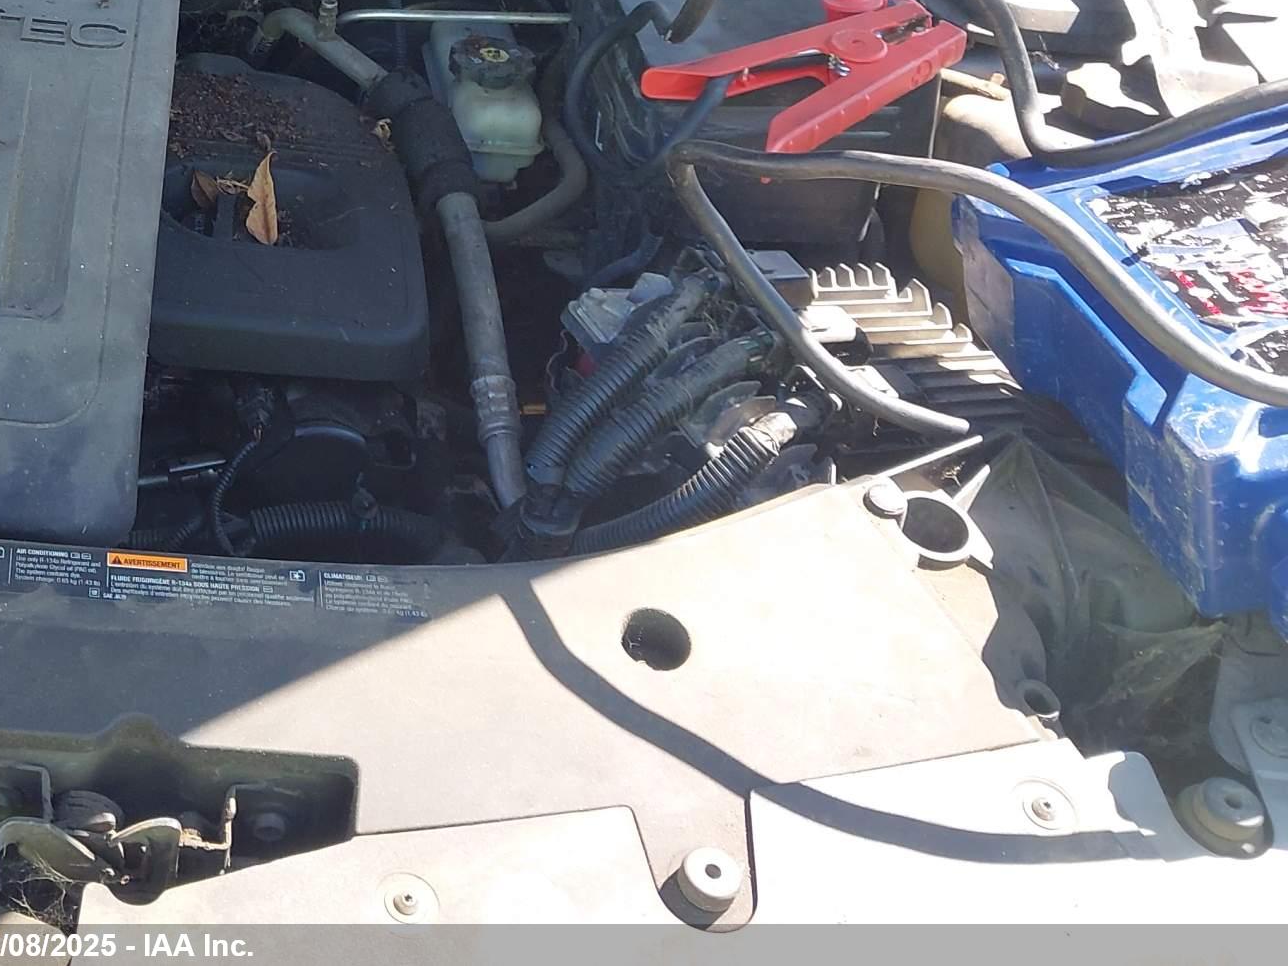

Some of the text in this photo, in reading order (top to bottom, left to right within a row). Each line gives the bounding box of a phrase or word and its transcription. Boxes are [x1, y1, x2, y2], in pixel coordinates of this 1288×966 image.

[28, 549, 69, 557] CONDITIONING
[123, 558, 180, 568] AVERTISSEMENT
[210, 582, 229, 590] HAUTE
